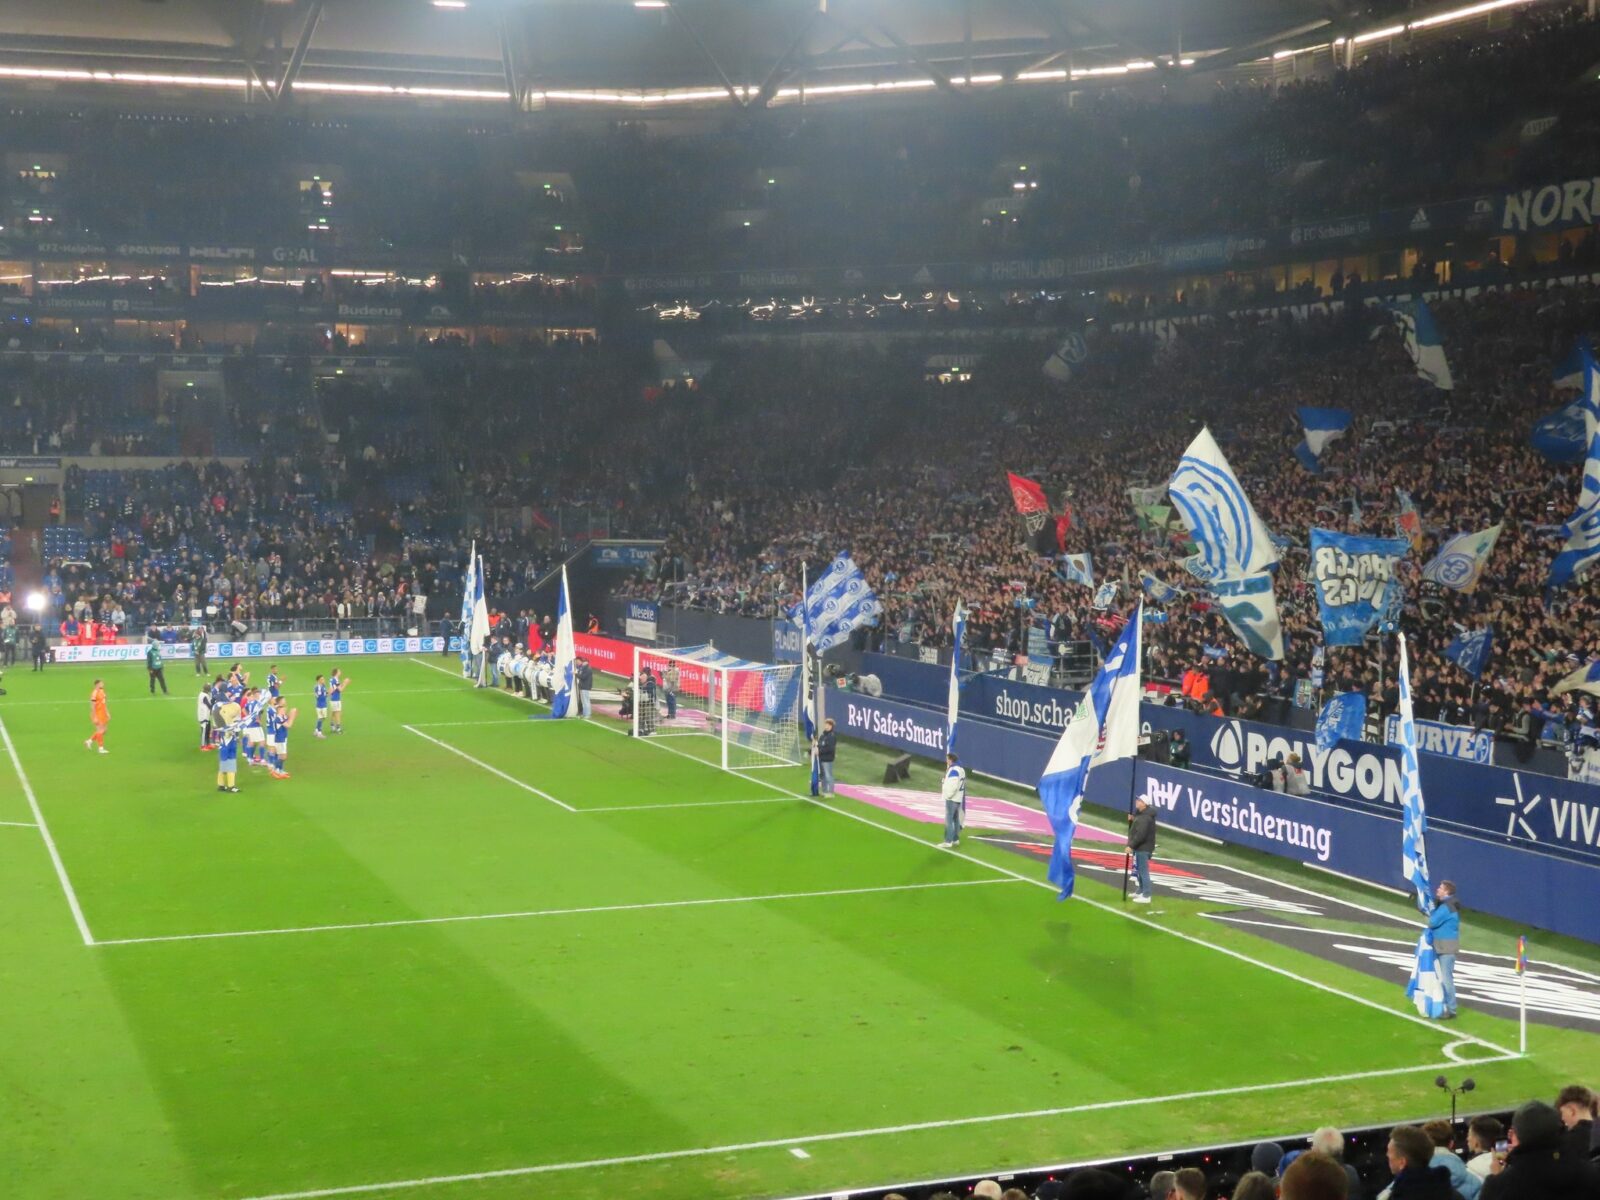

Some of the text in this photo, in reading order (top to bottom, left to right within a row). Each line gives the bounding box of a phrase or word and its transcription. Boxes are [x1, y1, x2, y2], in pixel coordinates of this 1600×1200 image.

[338, 304, 402, 316] Buderus
[91, 646, 140, 660] Energie
[848, 704, 943, 750] R+V Safe+Smart
[1146, 777, 1332, 861] R+V Versicherung
[1551, 798, 1600, 848] VIV
